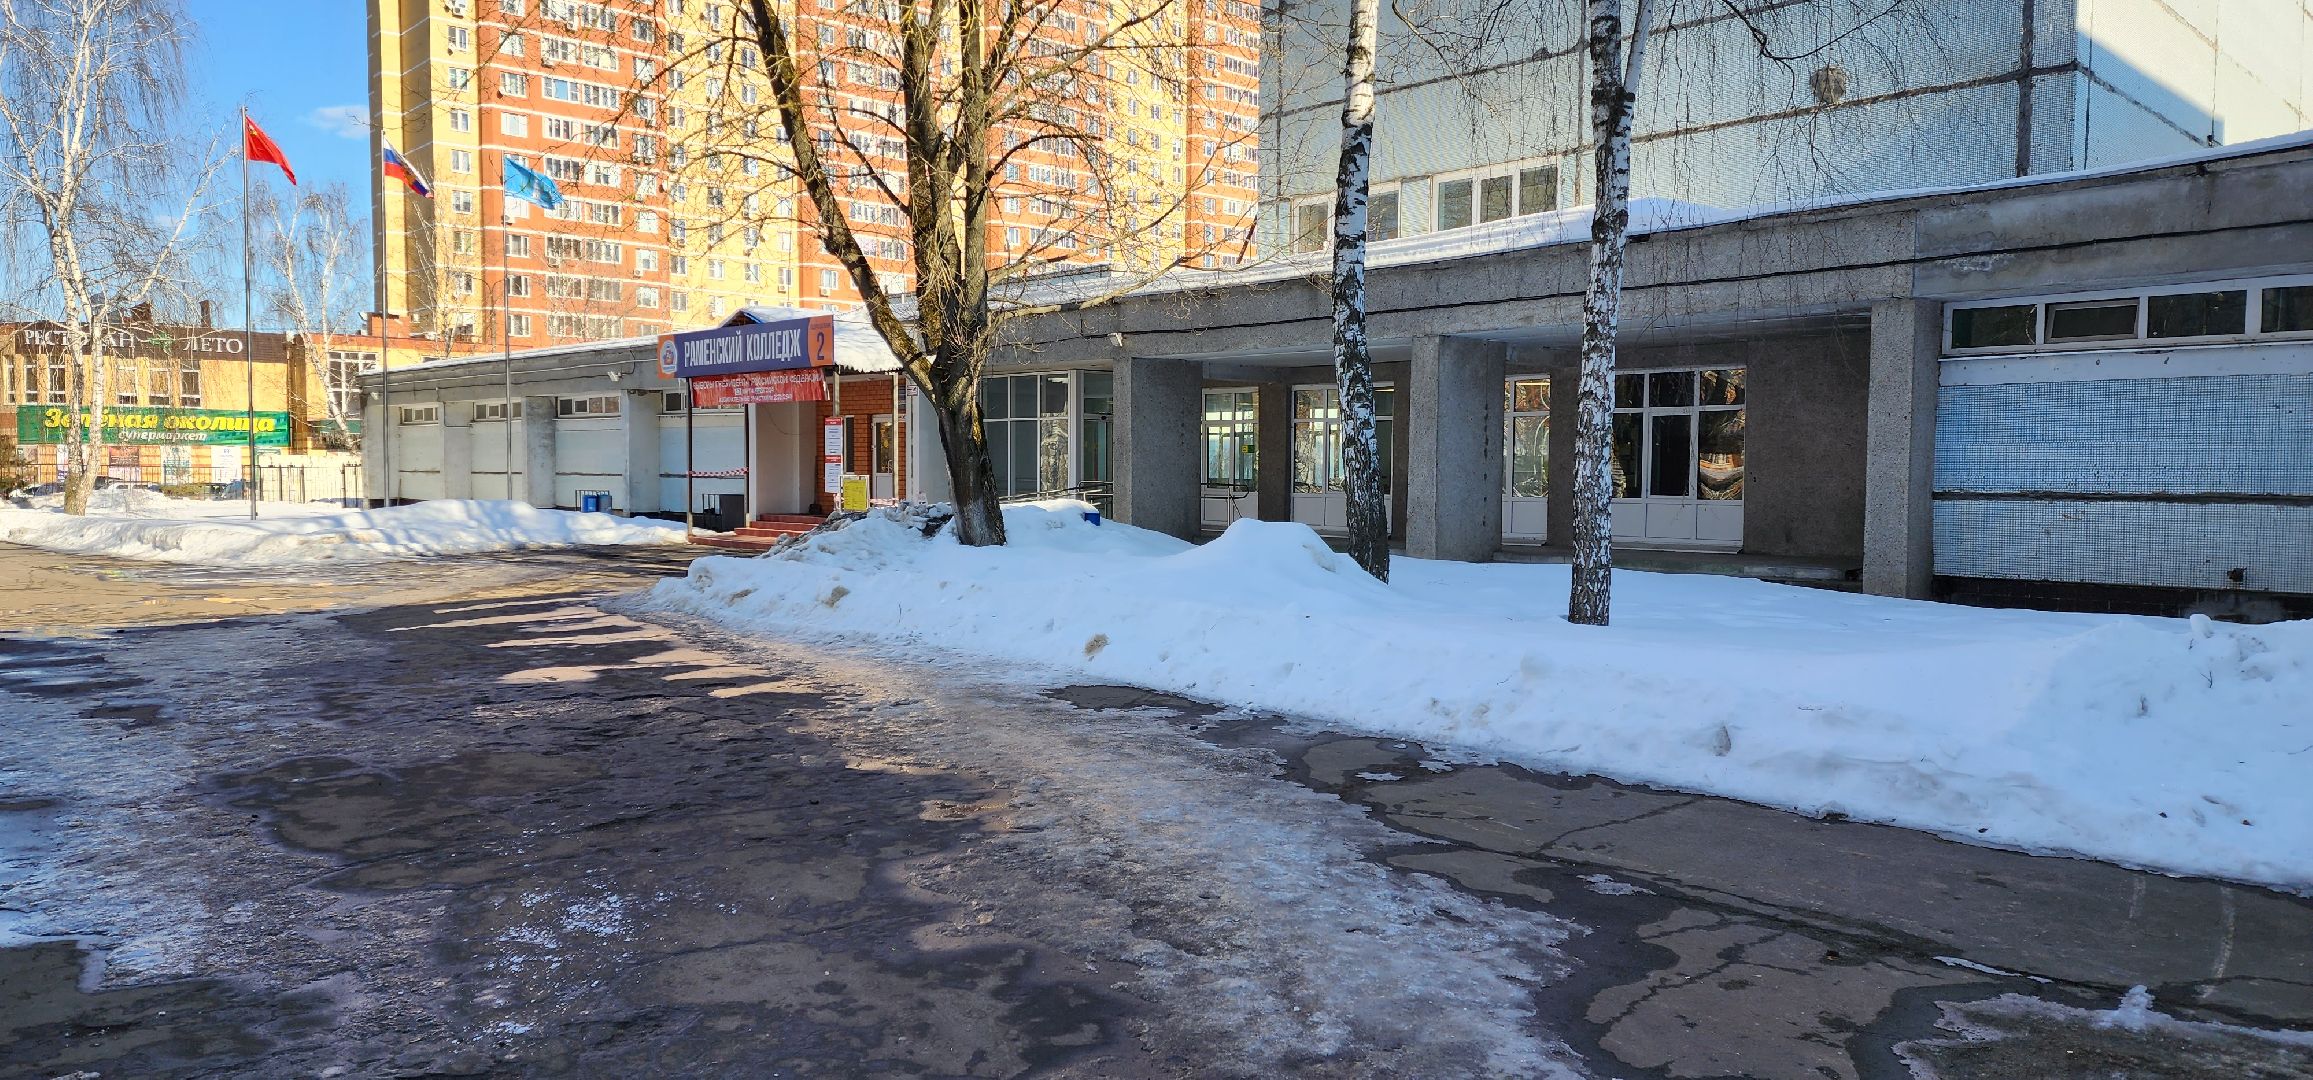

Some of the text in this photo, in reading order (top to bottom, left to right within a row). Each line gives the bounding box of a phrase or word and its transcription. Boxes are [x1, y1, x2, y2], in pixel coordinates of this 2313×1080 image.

[24, 329, 243, 354] РЕСТАН ЛЕТО
[684, 328, 825, 367] РАМЕНСКИЙ КОЛЛЕДЖ 2
[118, 430, 208, 441] супермаркет
[163, 416, 276, 434] околица
